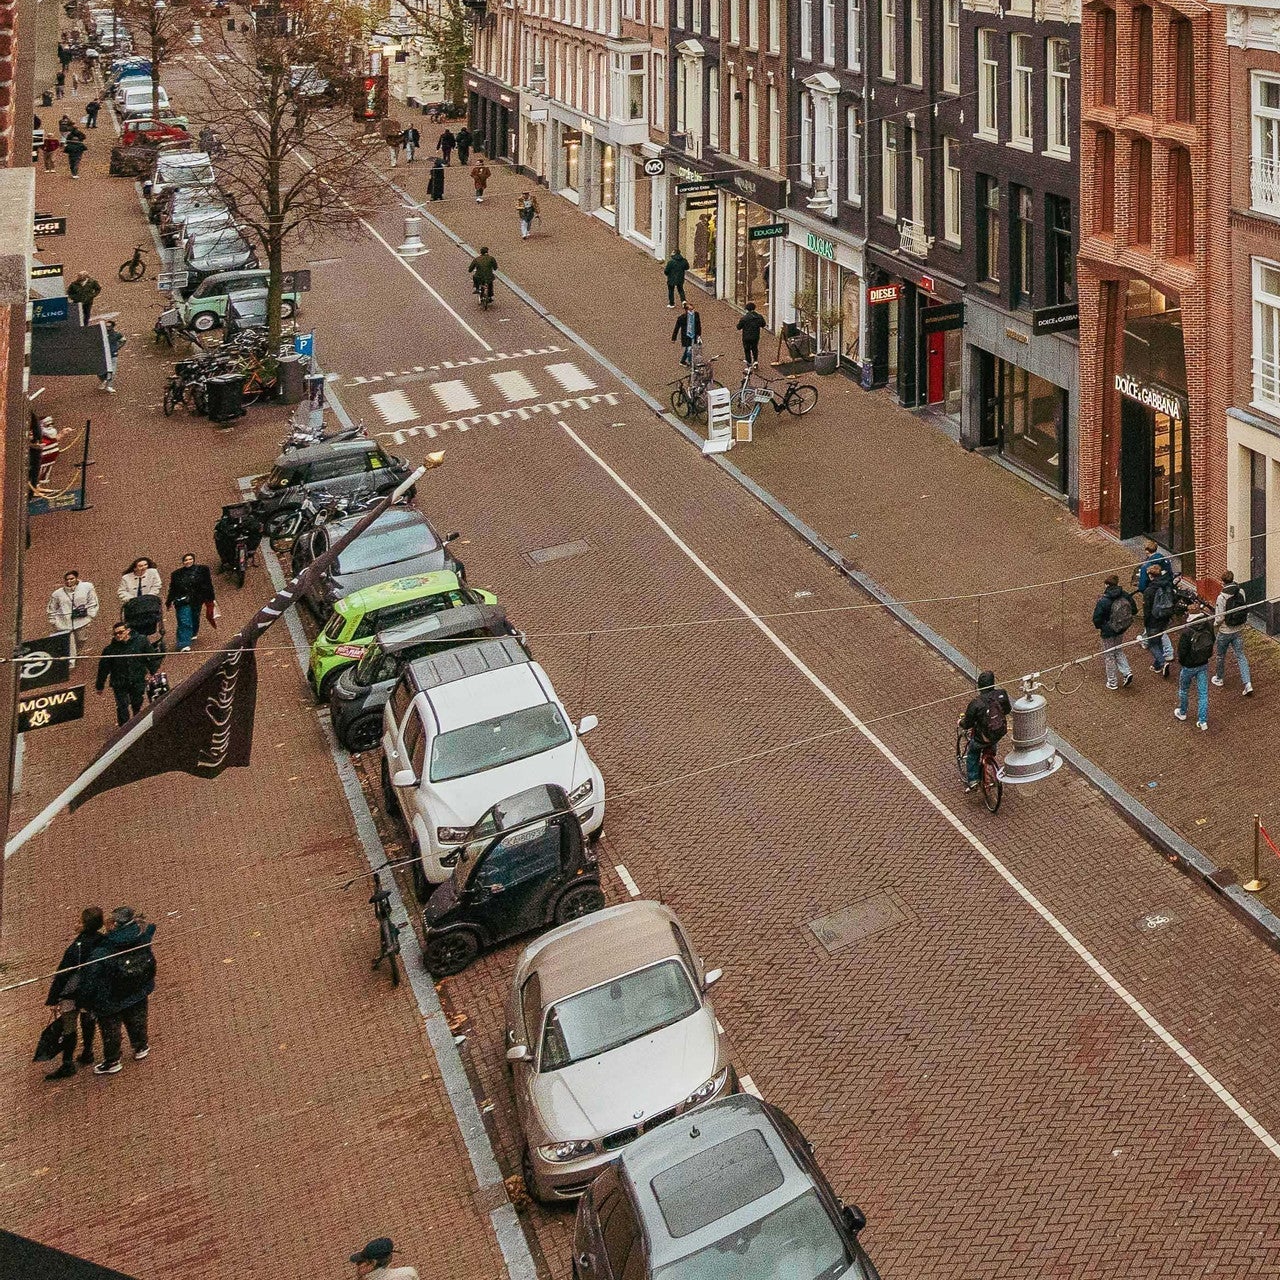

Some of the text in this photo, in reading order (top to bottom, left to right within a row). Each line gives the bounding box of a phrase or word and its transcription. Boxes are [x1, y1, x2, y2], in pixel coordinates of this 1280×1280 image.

[754, 227, 783, 237] DOUGLAS
[807, 232, 833, 259] DOUGLAS
[870, 287, 897, 300] DIESEL
